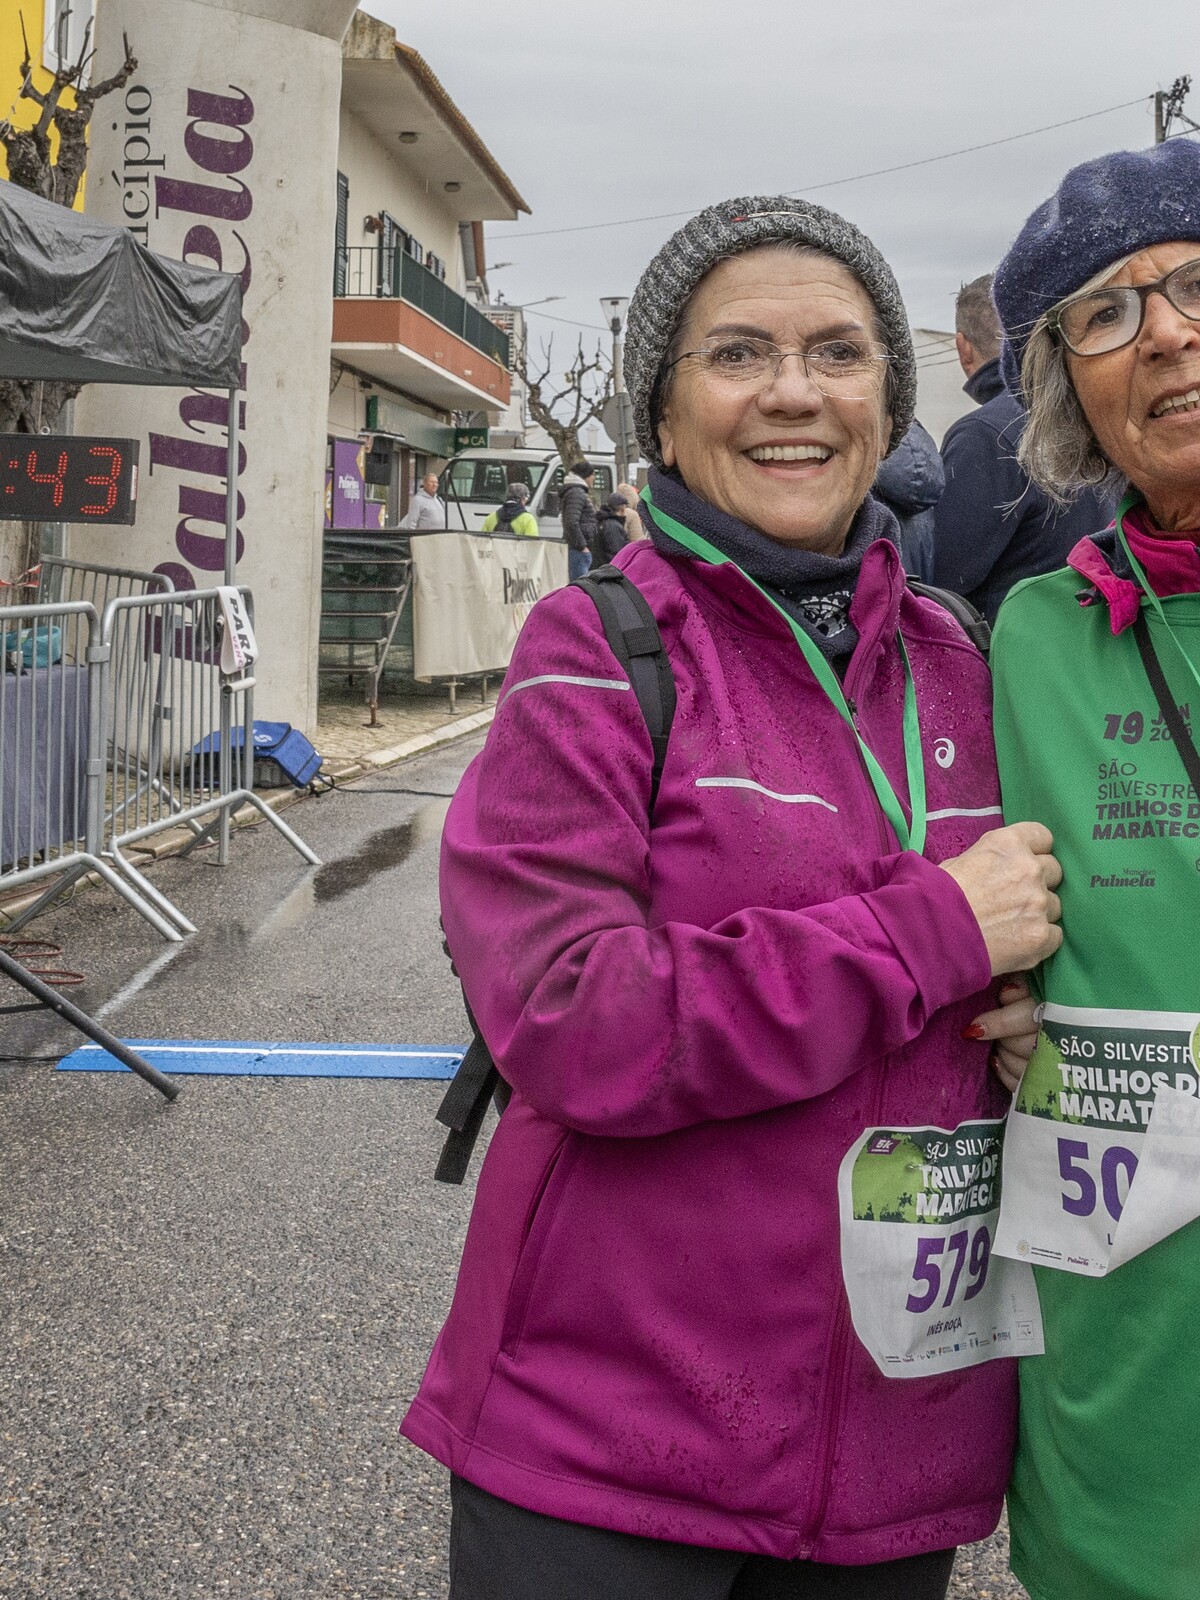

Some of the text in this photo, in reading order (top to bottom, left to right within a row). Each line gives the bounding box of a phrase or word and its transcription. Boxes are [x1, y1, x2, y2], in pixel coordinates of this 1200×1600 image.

[112, 85, 166, 247] icípio
[470, 435, 486, 447] CA
[229, 597, 254, 668] PARA
[232, 635, 245, 670] VENC
[1103, 702, 1191, 745] 19 JN
[1098, 757, 1137, 780] SÃO
[1097, 779, 1199, 801] SILVESTRE
[1095, 799, 1183, 821] TRILHOS
[1089, 873, 1156, 889] Palmela
[1060, 1036, 1193, 1064] SÃO SILVESTR
[1057, 1063, 1170, 1096] TRILHOS
[1058, 1091, 1153, 1125] MARAT
[1057, 1136, 1139, 1223] 50
[905, 1225, 991, 1314] 579
